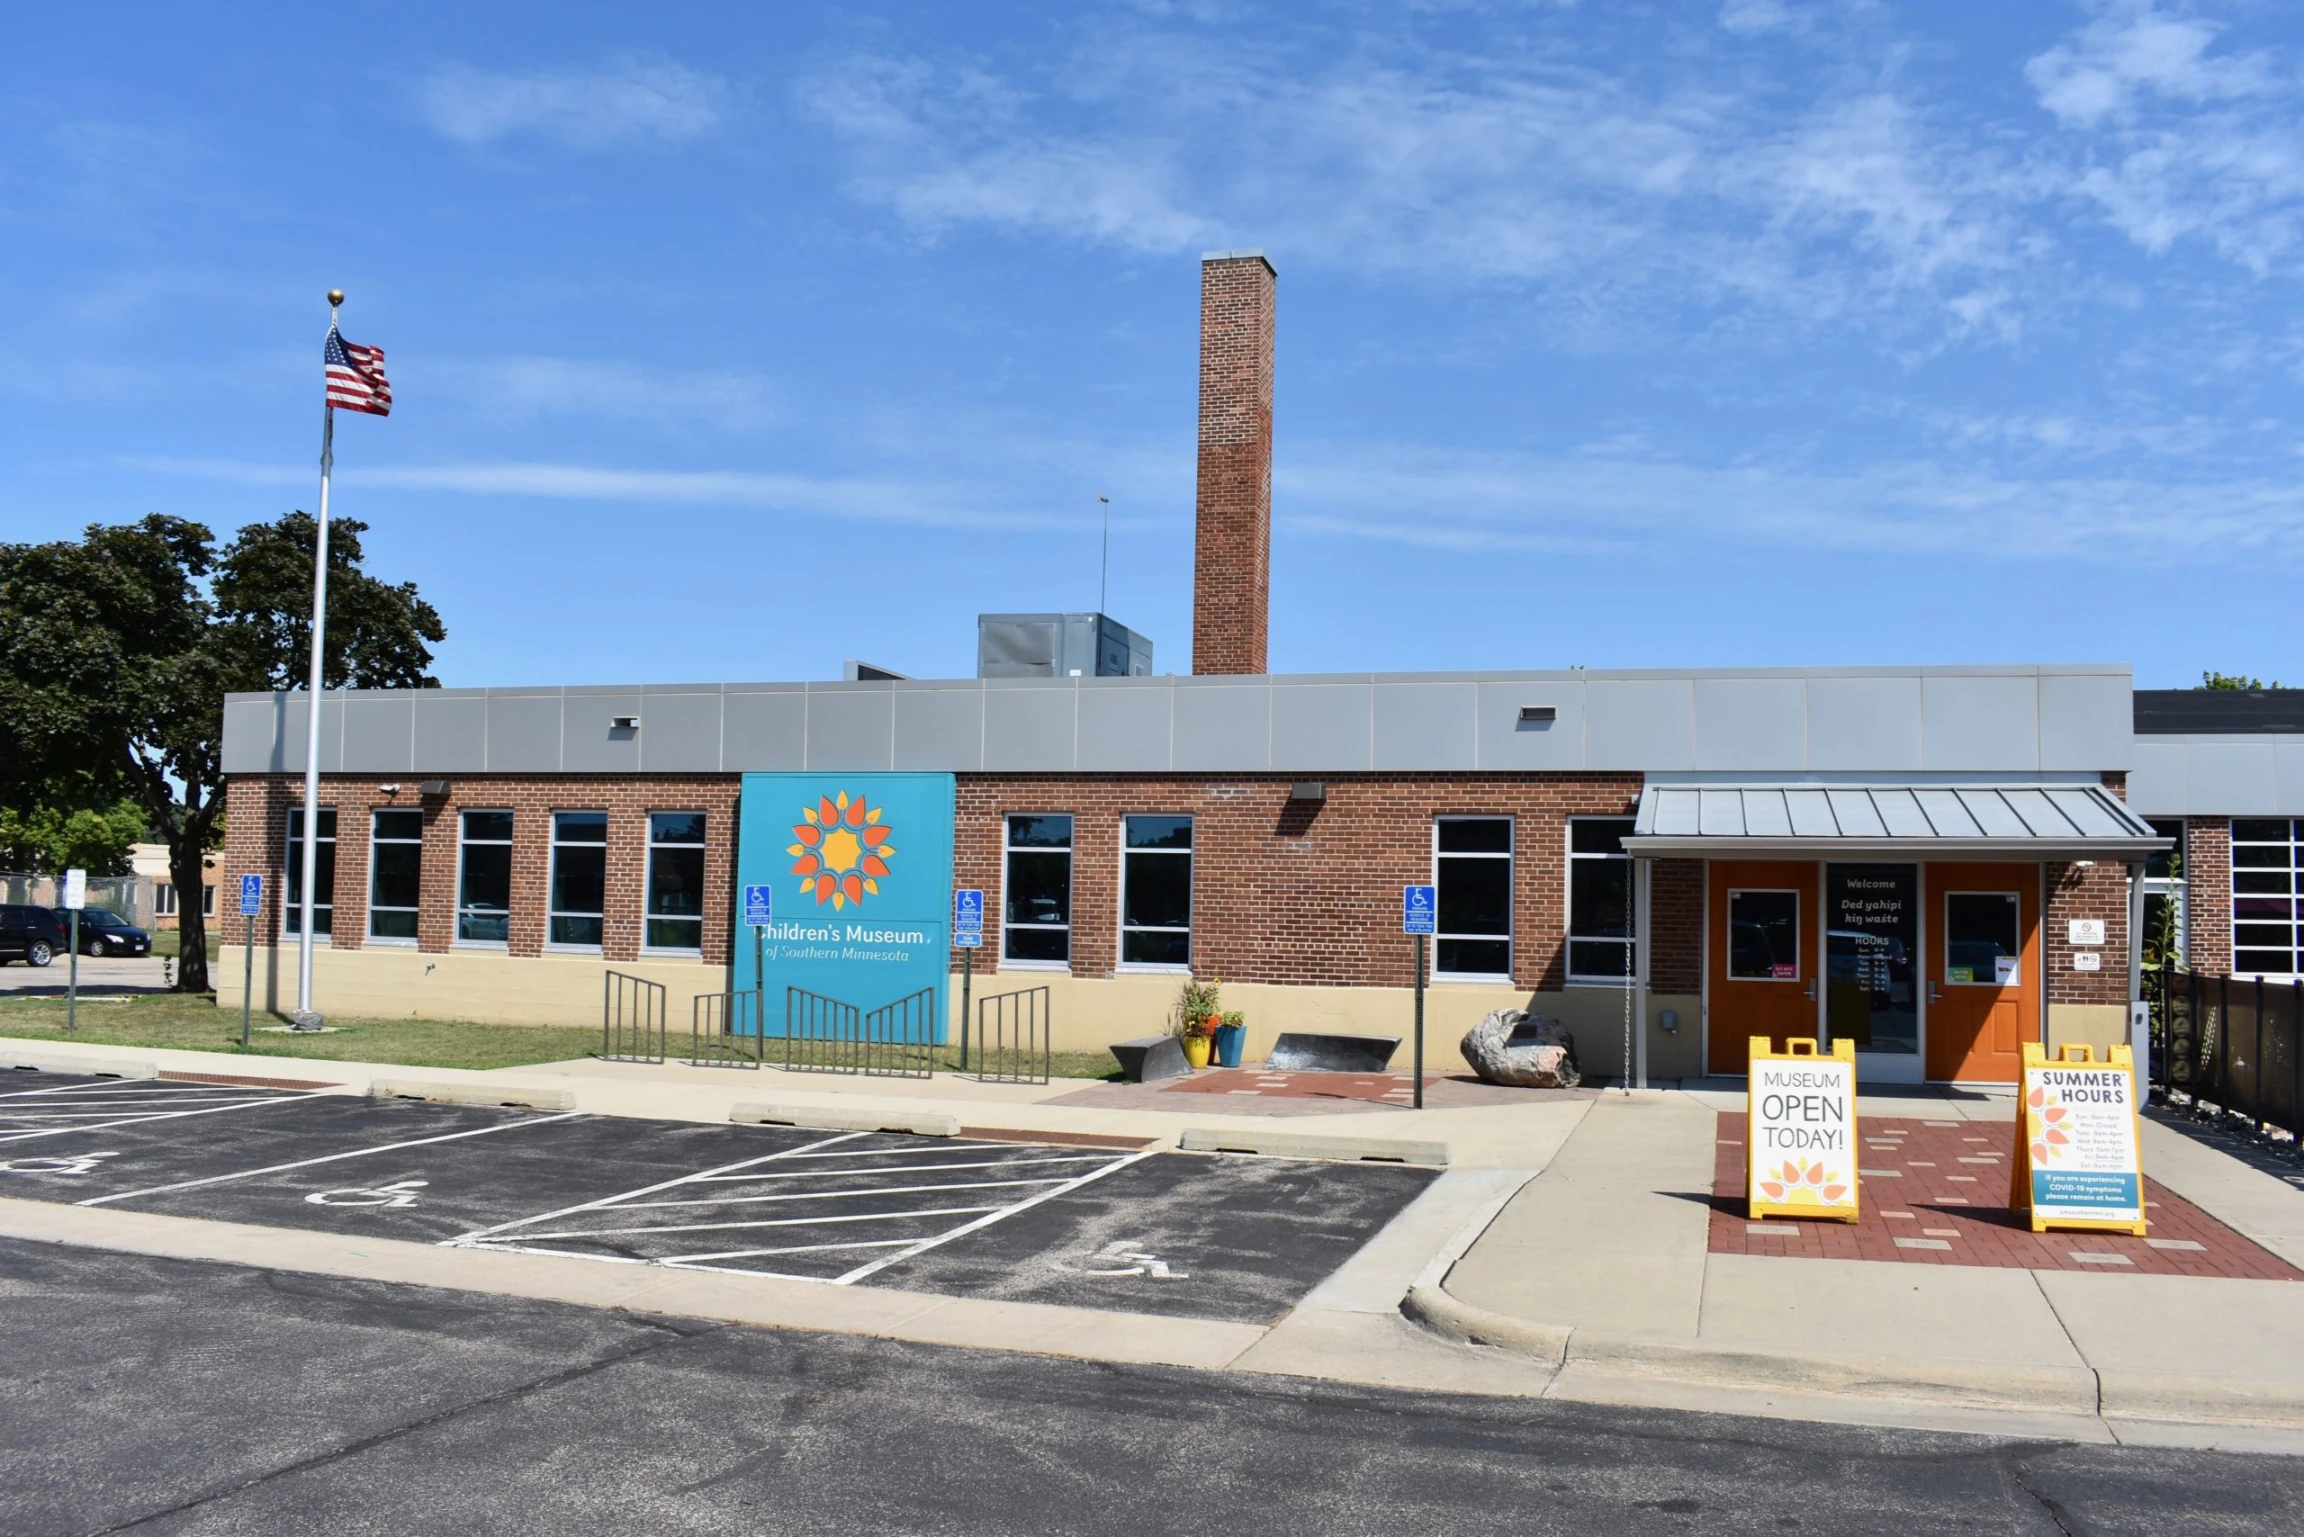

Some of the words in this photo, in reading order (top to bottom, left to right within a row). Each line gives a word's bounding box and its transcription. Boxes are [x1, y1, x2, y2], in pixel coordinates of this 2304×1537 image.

[1847, 878, 1896, 889] Welcome
[1865, 899, 1902, 912] yahipi
[846, 924, 923, 944] Museum
[1855, 936, 1890, 946] HOURS
[765, 944, 780, 961] of
[780, 944, 840, 960] Southern
[841, 946, 909, 962] Minnesota
[1764, 1072, 1840, 1089] MUSEUM
[2042, 1071, 2123, 1087] SUMMER
[2061, 1089, 2124, 1103] HOURS
[1762, 1094, 1843, 1122] OPEN
[1762, 1126, 1843, 1150] TODAY!
[2079, 1175, 2126, 1185] experiencing
[2049, 1183, 2085, 1192] COVID-19
[2045, 1192, 2069, 1200] please
